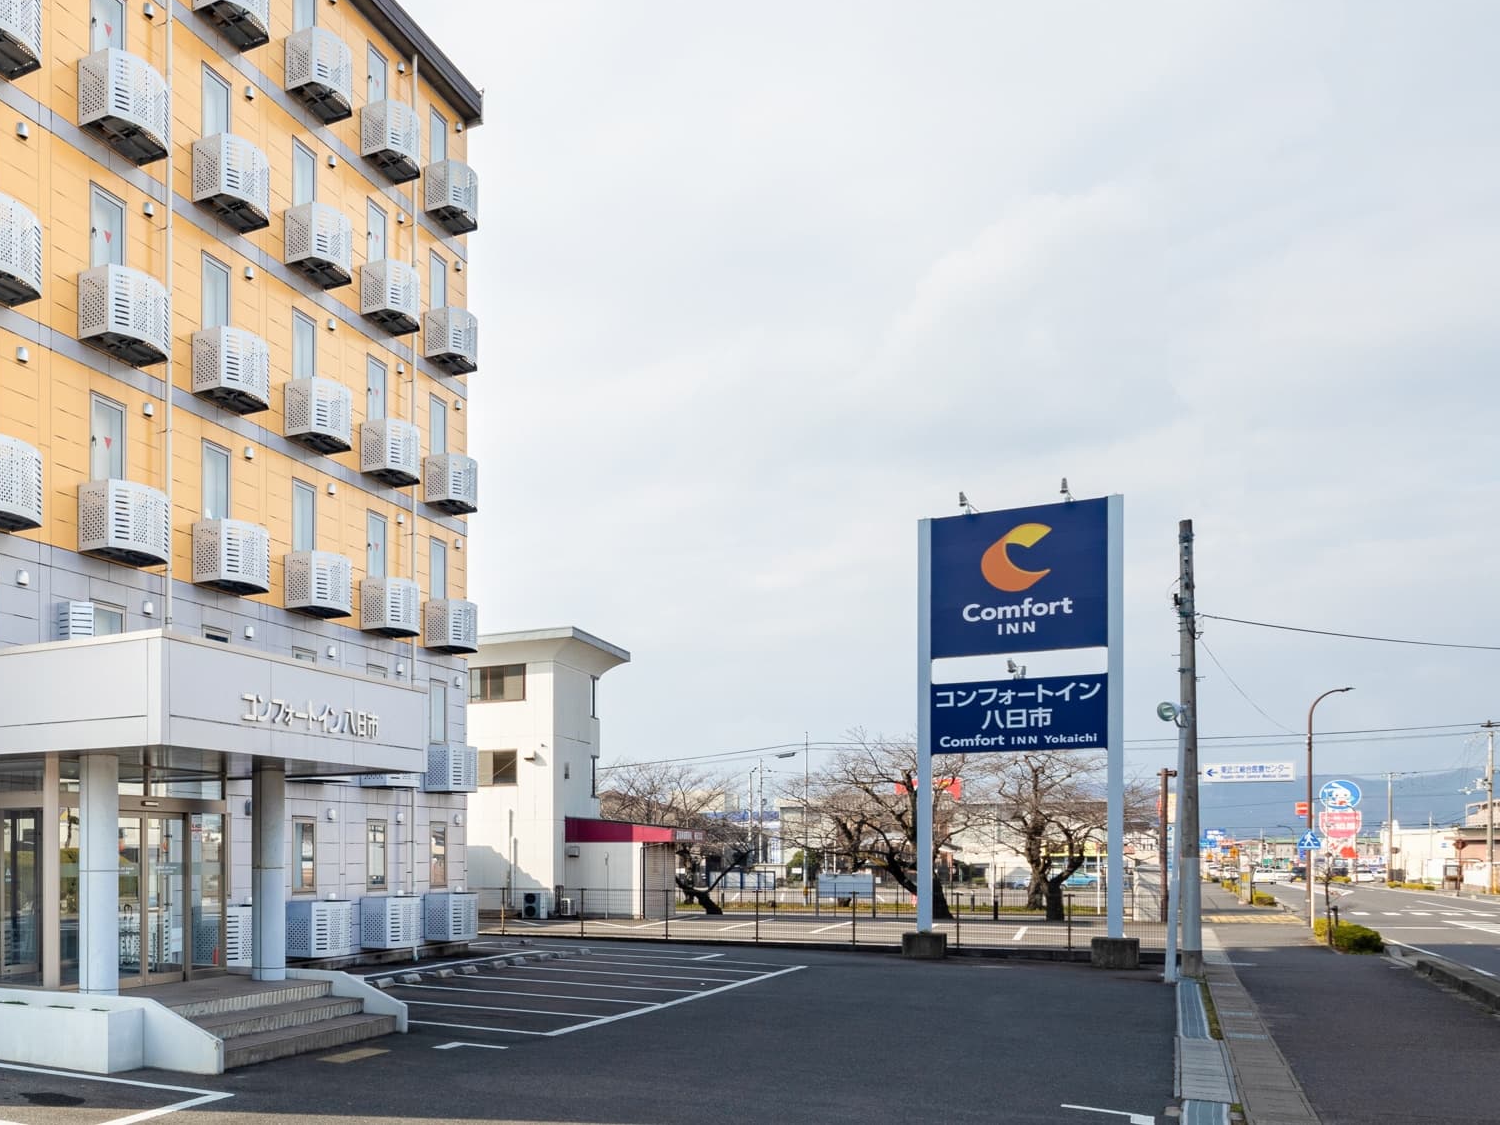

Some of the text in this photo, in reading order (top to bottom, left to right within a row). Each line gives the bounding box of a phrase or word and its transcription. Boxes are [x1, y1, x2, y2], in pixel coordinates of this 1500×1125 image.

[962, 597, 1073, 622] Comfort
[998, 621, 1036, 635] INN
[936, 682, 1102, 708] コンフォートイン
[981, 707, 1053, 730] 八日市
[939, 733, 1098, 748] Comfort INN Yokaichi
